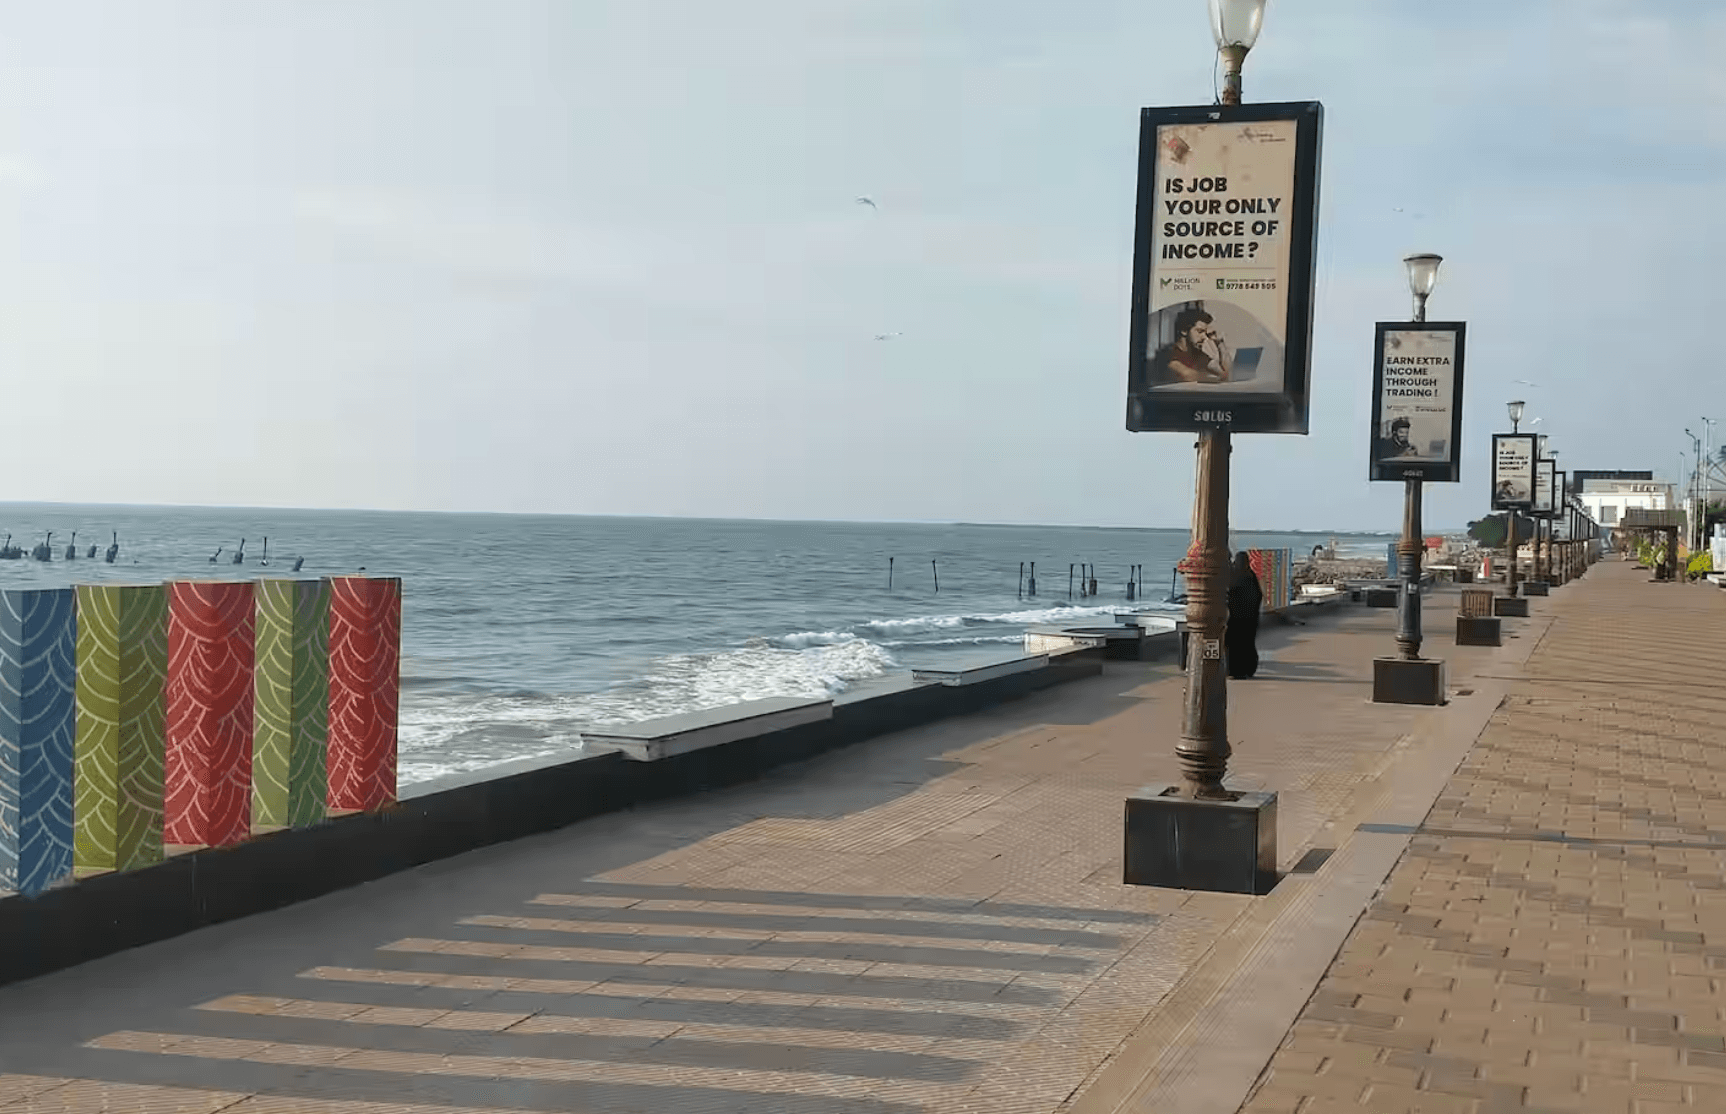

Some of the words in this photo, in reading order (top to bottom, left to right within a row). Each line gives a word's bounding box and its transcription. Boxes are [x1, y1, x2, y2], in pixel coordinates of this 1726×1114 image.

[1165, 178, 1184, 194] IS
[1187, 177, 1227, 193] JOB
[1164, 199, 1221, 215] YOUR
[1225, 198, 1281, 214] ONLY
[1163, 221, 1245, 237] SOURCE
[1251, 220, 1279, 236] OF
[1386, 356, 1415, 365] EARN
[1416, 357, 1450, 365] EXTRA
[1386, 367, 1429, 376] INCOME
[1385, 378, 1437, 387] THROUGH
[1194, 410, 1233, 422] SOLUS
[1204, 650, 1218, 658] 05
